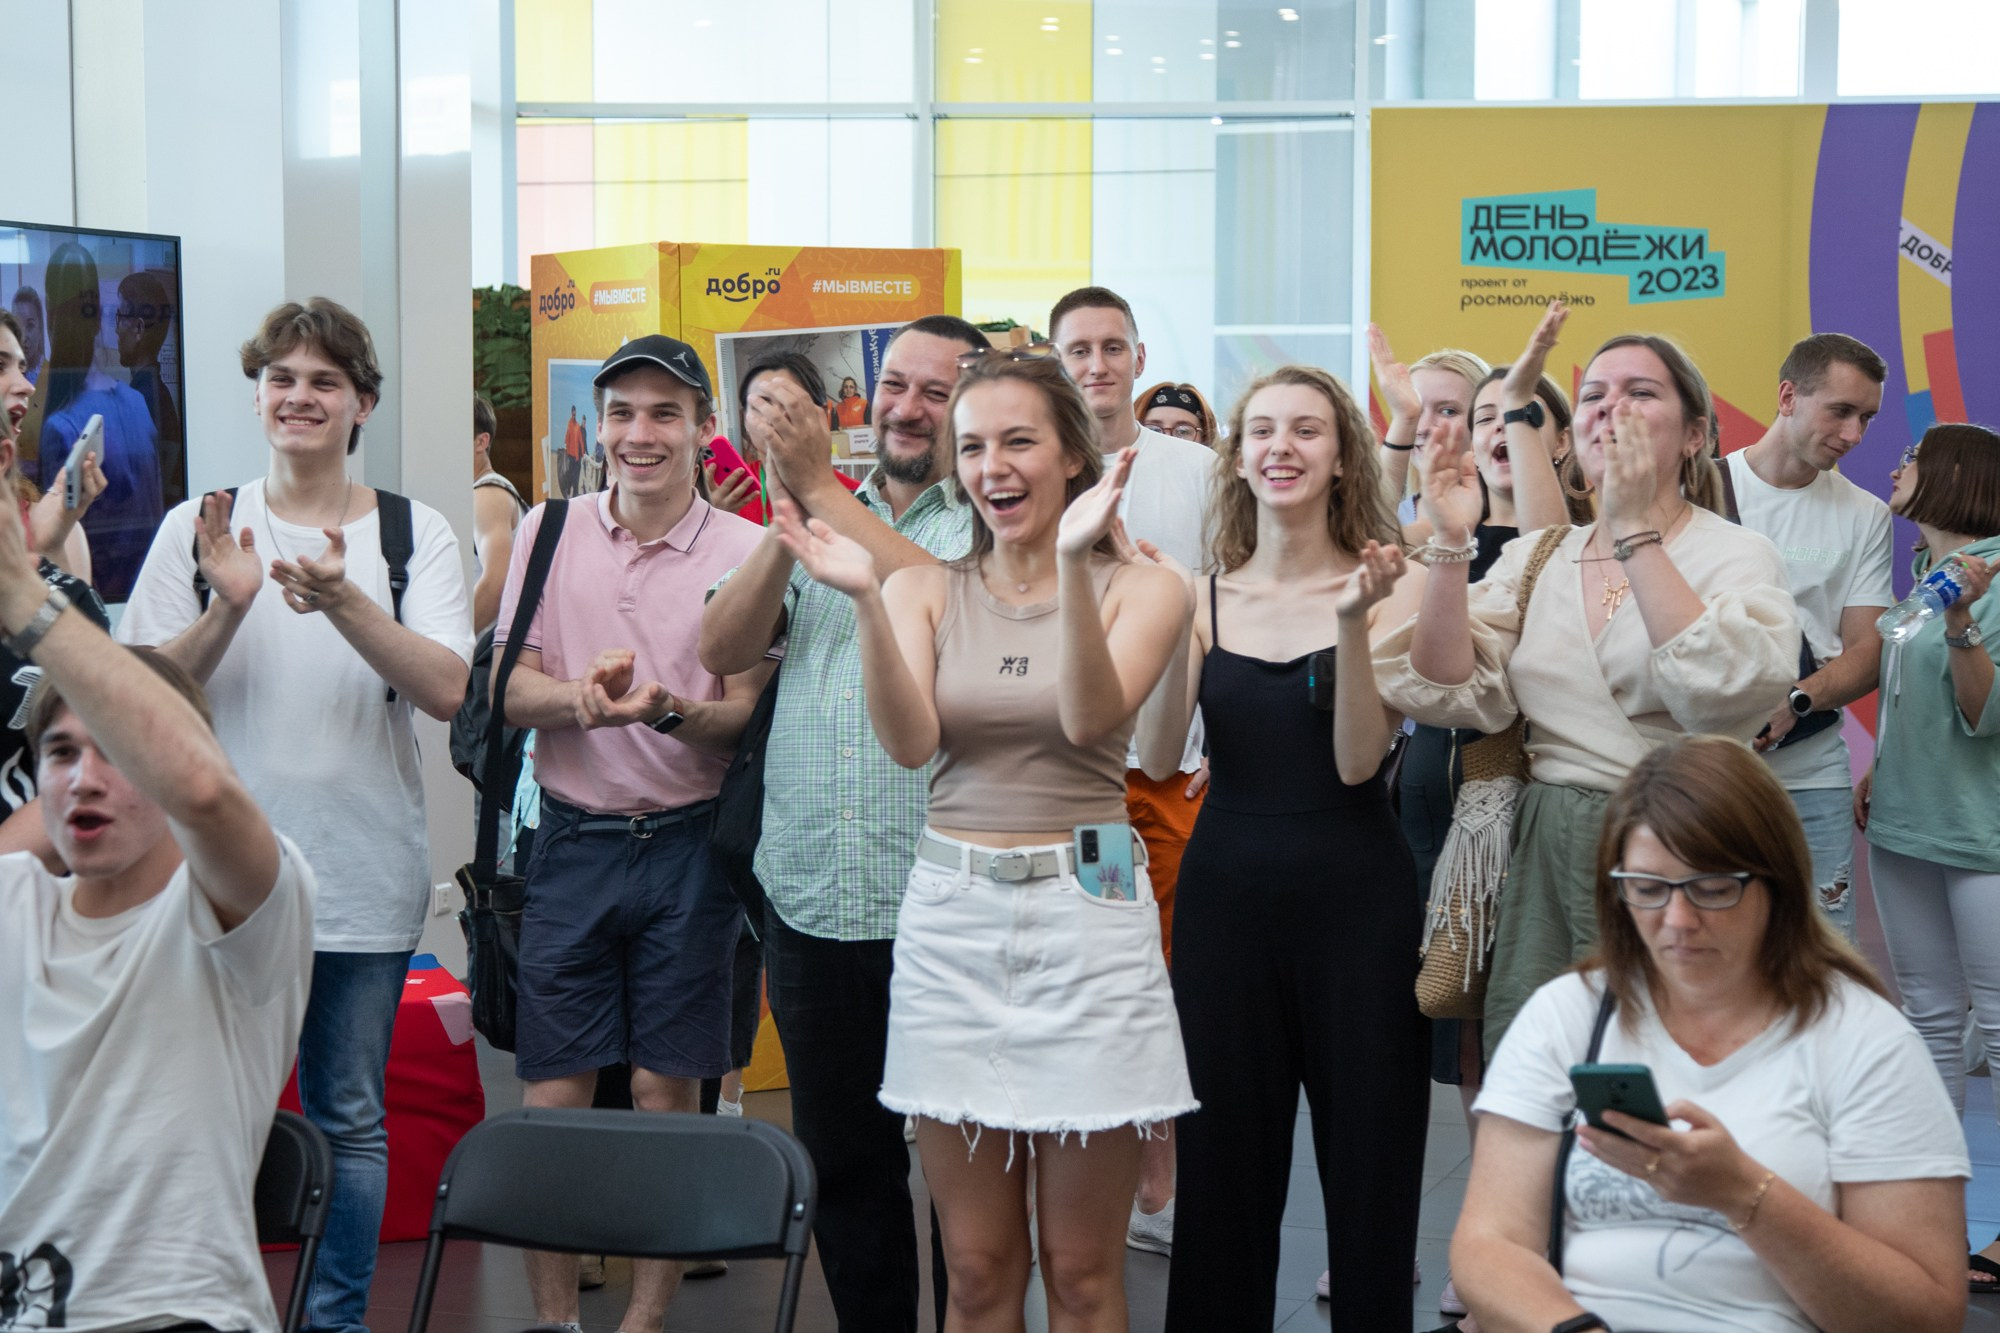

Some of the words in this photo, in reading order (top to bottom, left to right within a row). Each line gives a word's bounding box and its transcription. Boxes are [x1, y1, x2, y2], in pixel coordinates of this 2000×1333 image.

[1470, 205, 1589, 234] ДЕНЬ
[1470, 229, 1705, 265] МОЛОДЁЖИ
[765, 267, 781, 276] .ru
[1461, 277, 1508, 290] проект
[1512, 278, 1528, 288] от
[1637, 264, 1719, 295] 2023
[593, 287, 647, 306] #МЫВМЕСТЕ
[706, 272, 781, 299] добро
[812, 279, 912, 295] #МЫВМЕСТЕ
[539, 287, 575, 316] добро
